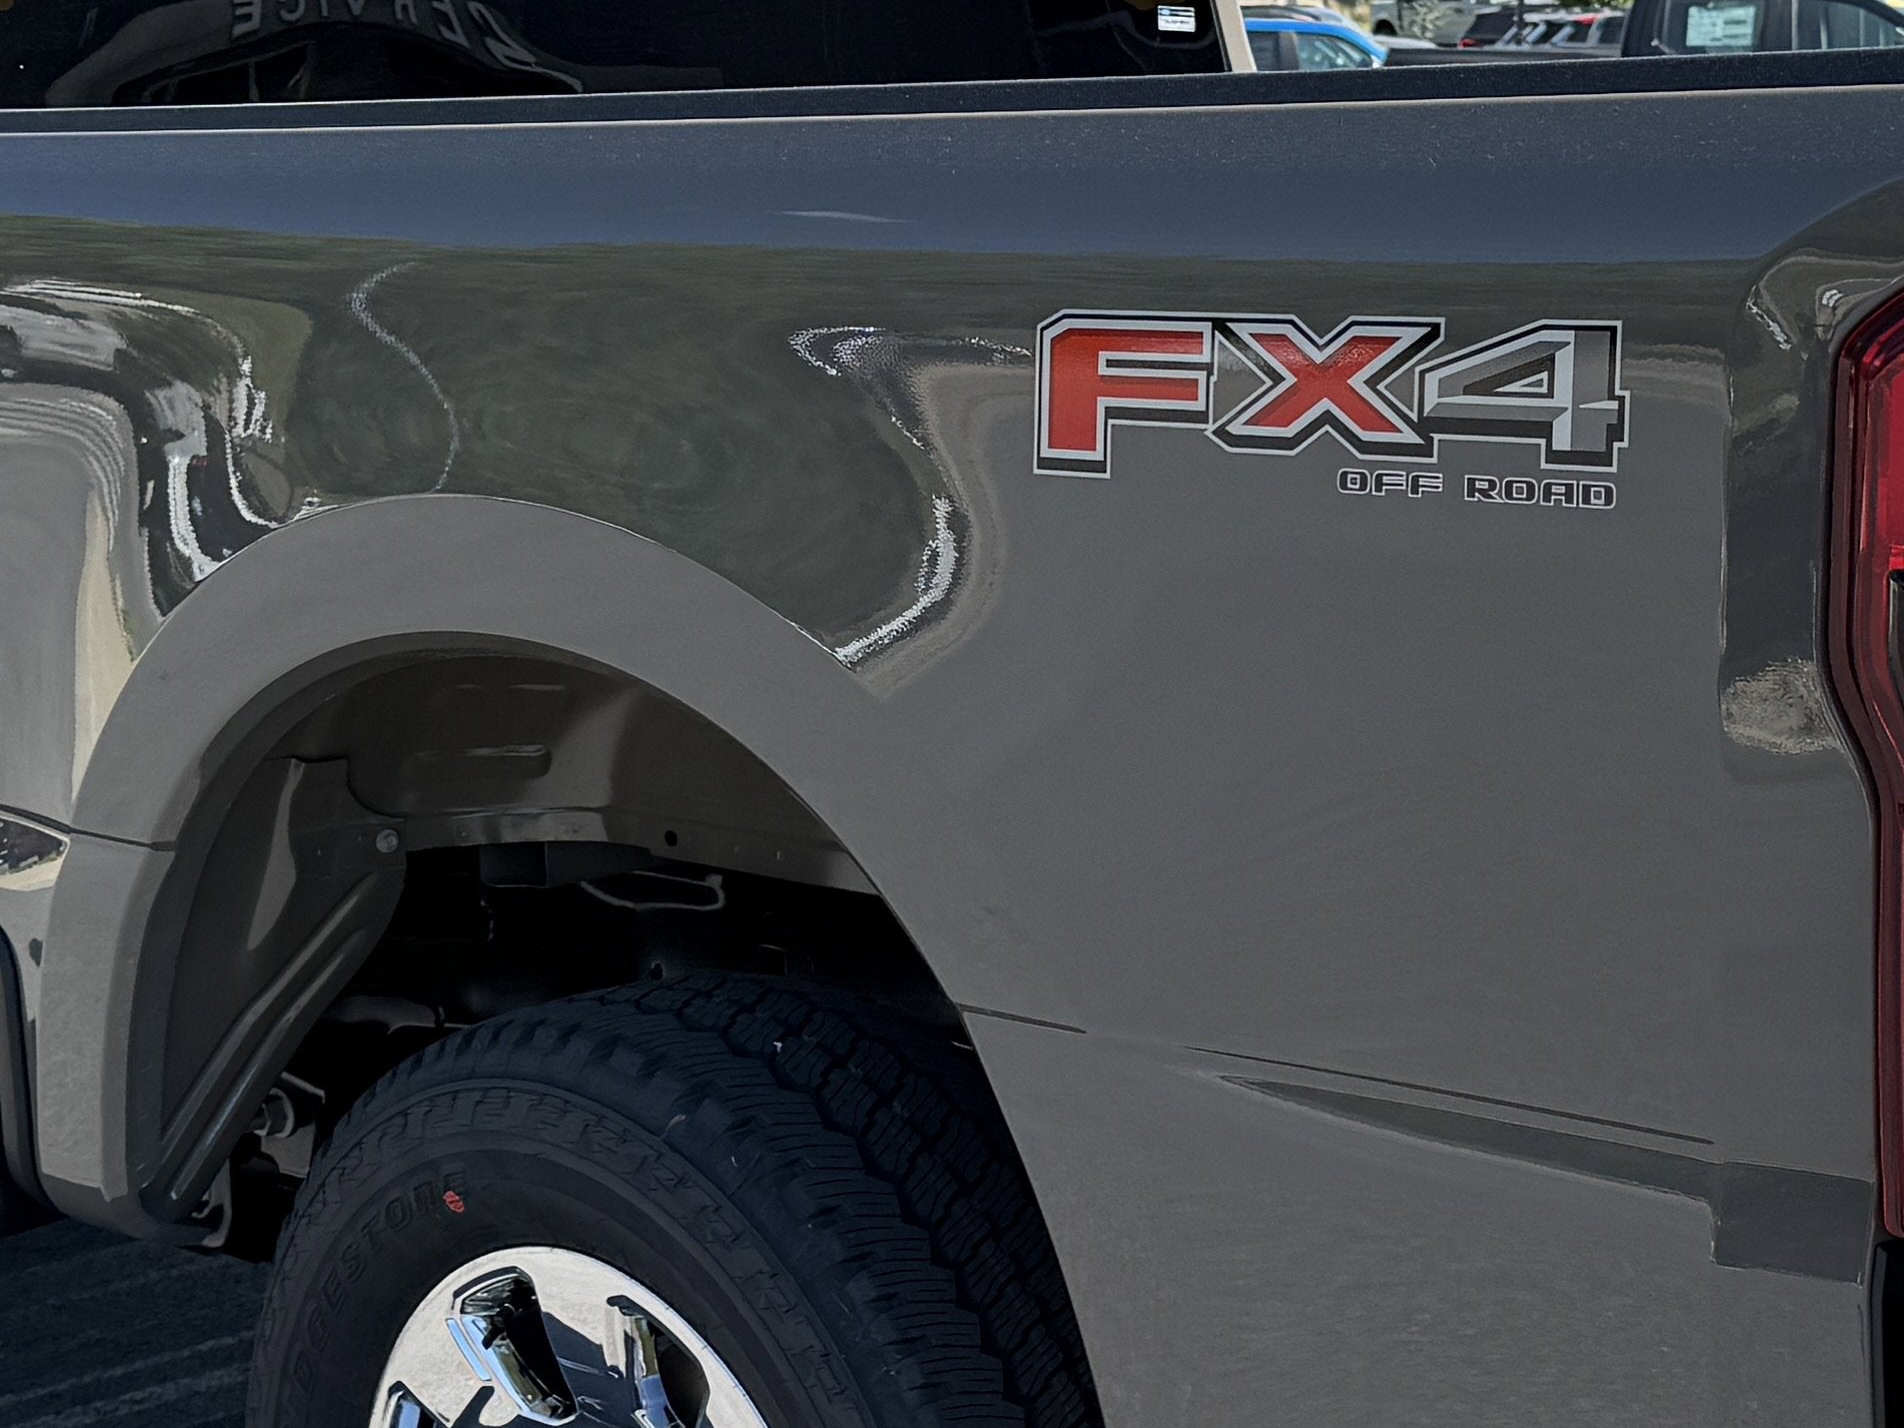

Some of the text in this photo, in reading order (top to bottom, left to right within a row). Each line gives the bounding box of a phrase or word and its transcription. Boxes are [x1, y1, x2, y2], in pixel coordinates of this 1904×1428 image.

[1033, 309, 1630, 479] FX4
[1336, 468, 1617, 510] OFF ROAD
